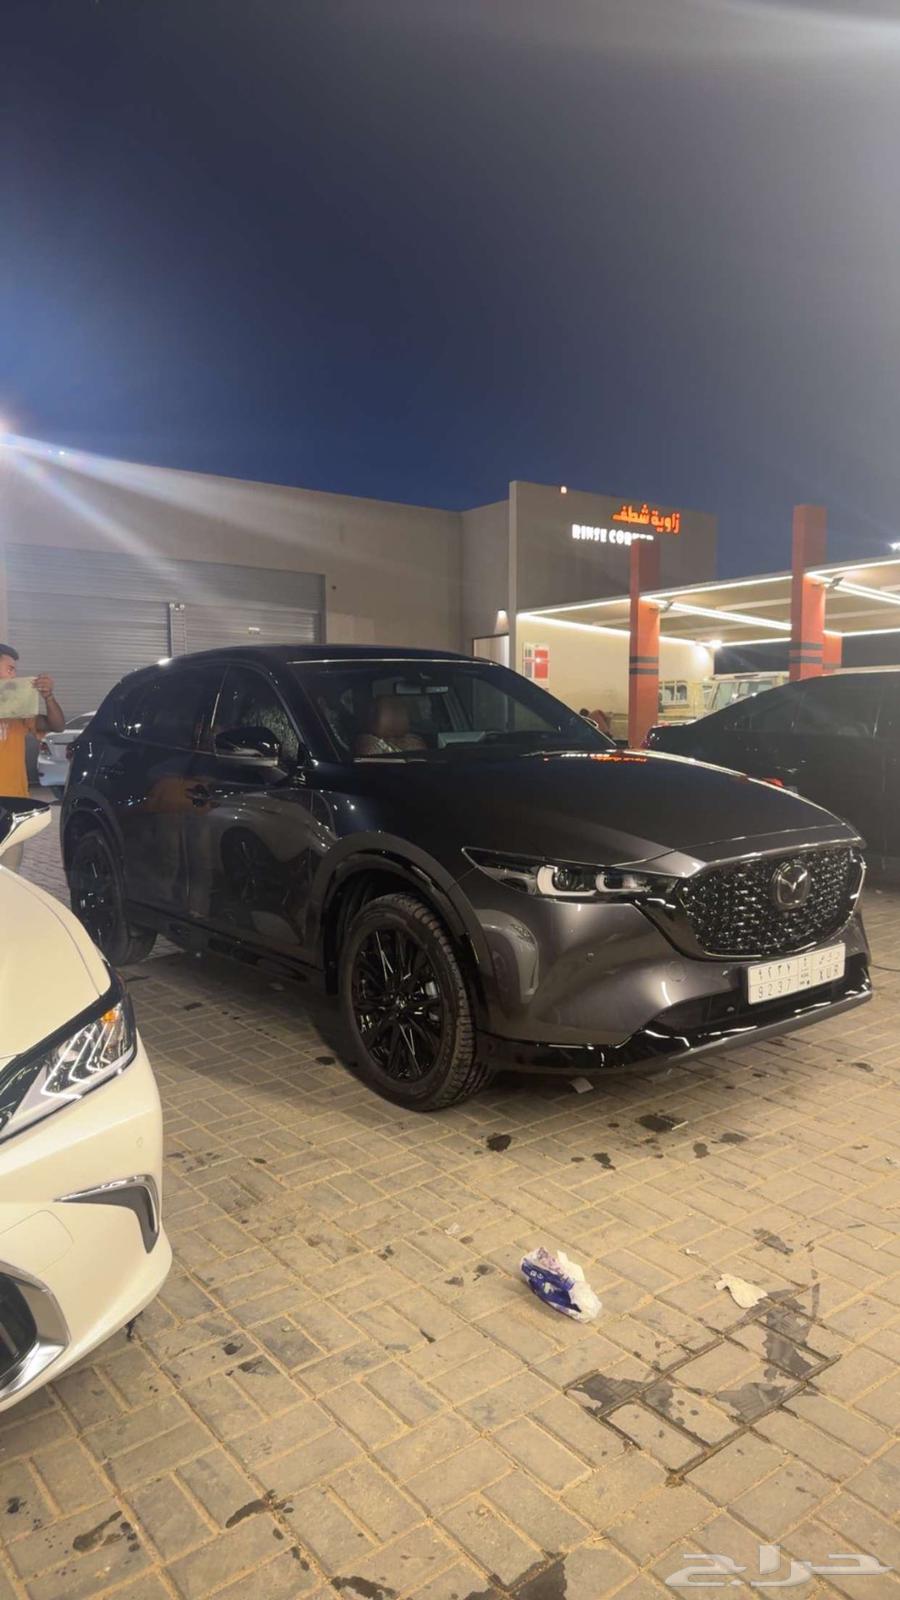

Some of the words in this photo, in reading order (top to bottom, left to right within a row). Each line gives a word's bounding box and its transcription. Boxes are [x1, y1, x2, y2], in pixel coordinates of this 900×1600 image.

[612, 504, 650, 525] شطف
[650, 509, 680, 534] زاوية
[571, 524, 608, 543] RINSE
[608, 528, 654, 546] COR
[758, 978, 792, 999] 9237
